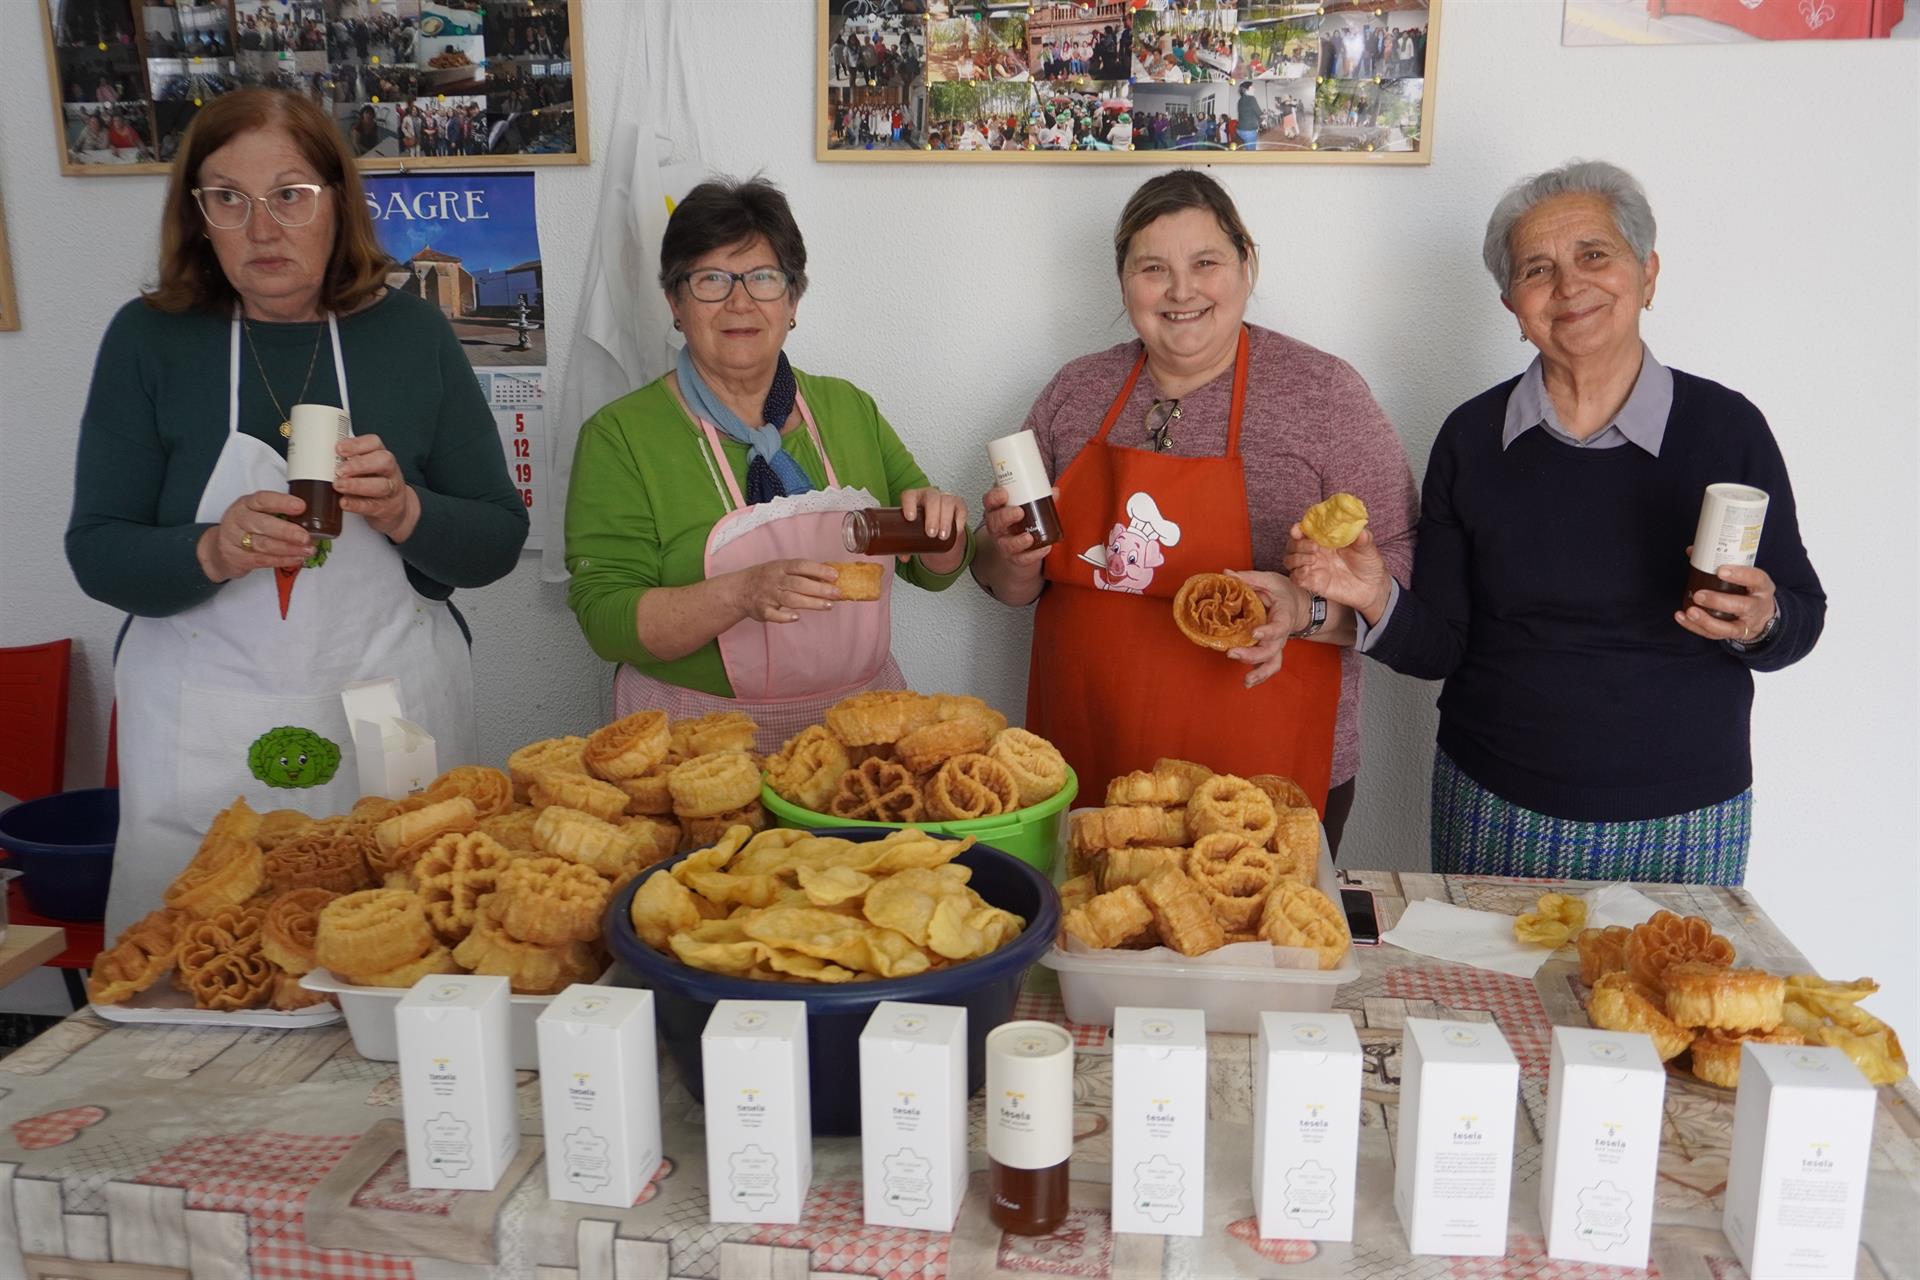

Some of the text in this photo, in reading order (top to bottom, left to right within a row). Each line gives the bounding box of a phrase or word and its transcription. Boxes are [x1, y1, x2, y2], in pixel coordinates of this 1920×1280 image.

[515, 413, 524, 433] 5
[513, 438, 530, 457] 12
[515, 463, 532, 482] 19
[1000, 1107, 1031, 1121] tesela
[1146, 1113, 1175, 1122] tesela
[1299, 1119, 1328, 1128] tesela
[1453, 1132, 1482, 1140] tesela
[1595, 1138, 1627, 1149] tesela
